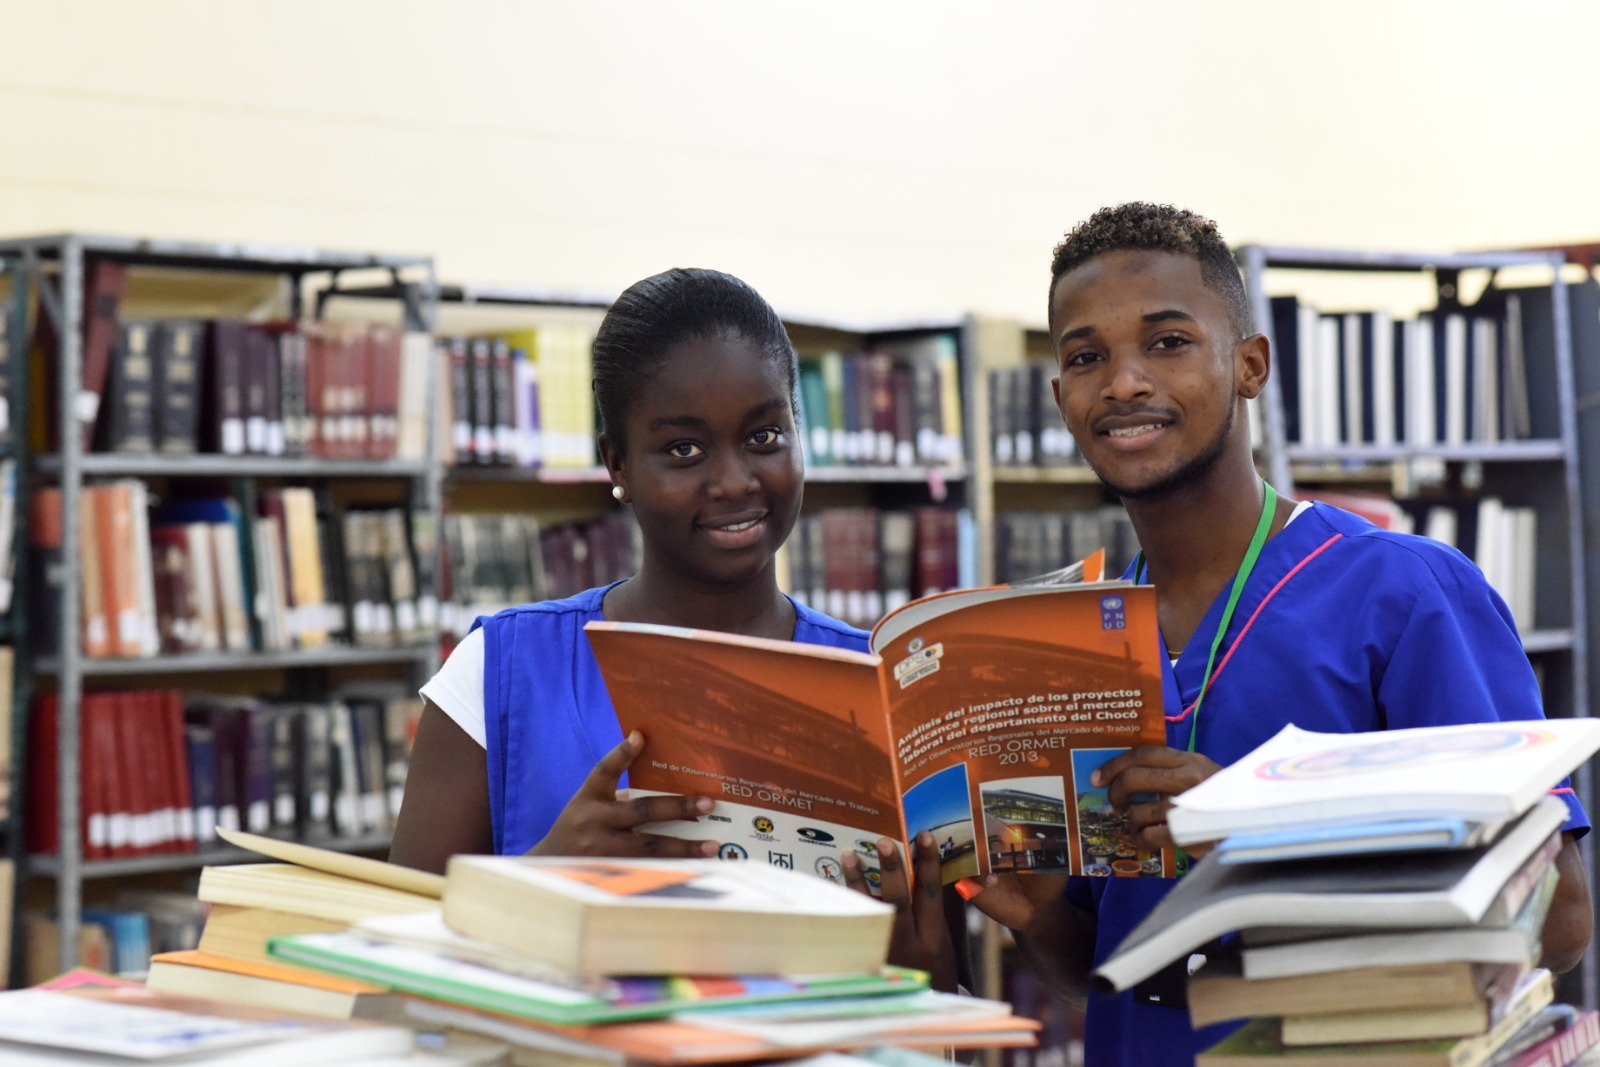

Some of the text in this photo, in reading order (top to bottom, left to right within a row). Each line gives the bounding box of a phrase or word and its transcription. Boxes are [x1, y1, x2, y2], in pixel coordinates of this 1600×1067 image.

[898, 689, 1141, 748] Análisis del impacto de los proyectos
[899, 699, 1143, 758] de alcance regional sobre el mercado
[903, 709, 1138, 765] laboral del departamento del Chocó
[903, 764, 917, 777] Red
[918, 758, 928, 767] de
[929, 738, 986, 761] Observatorios
[988, 730, 1034, 742] Regionales
[1053, 726, 1090, 735] Mercado
[1107, 724, 1140, 733] Trabajo
[969, 736, 1066, 759] RED ORMET
[999, 751, 1039, 765] 2013
[652, 760, 668, 769] Red
[681, 766, 737, 783] Observatorios
[739, 777, 782, 793] Regionales
[784, 787, 798, 795] del
[800, 791, 834, 804] Mercado
[836, 798, 847, 807] de
[848, 801, 880, 815] Trabajo
[721, 782, 813, 811] RED ORMET
